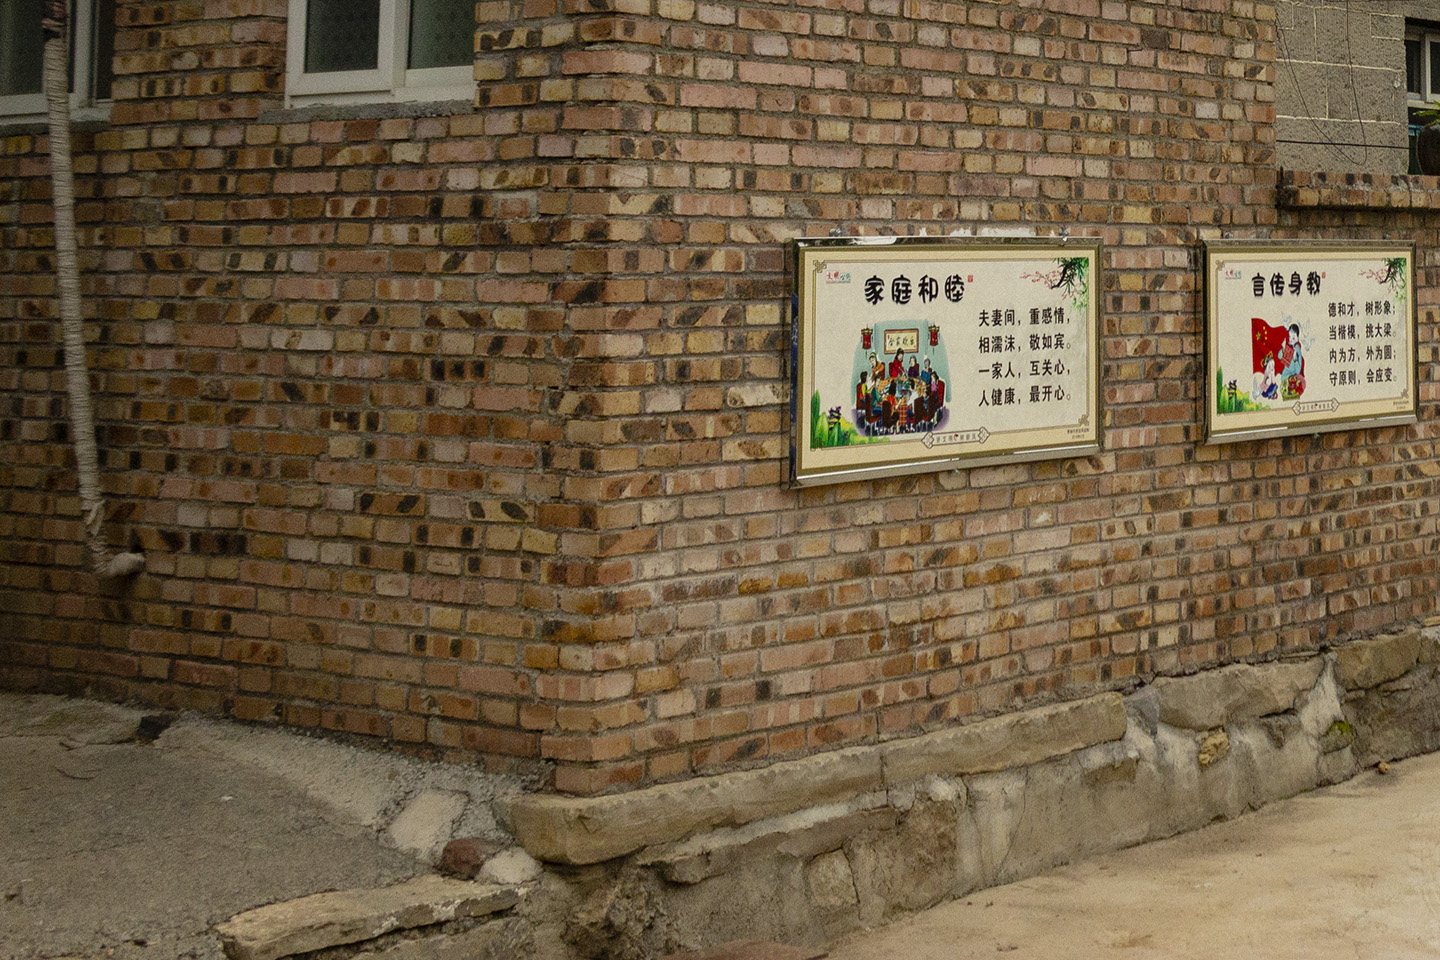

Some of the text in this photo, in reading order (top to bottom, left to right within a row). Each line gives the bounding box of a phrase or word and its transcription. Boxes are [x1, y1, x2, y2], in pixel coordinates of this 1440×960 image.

[864, 274, 966, 305] 家庭和睦
[1251, 270, 1321, 297] 言传身教
[978, 359, 1070, 380] 一家人，互关心，
[978, 384, 1071, 407] 人健康，最开心。
